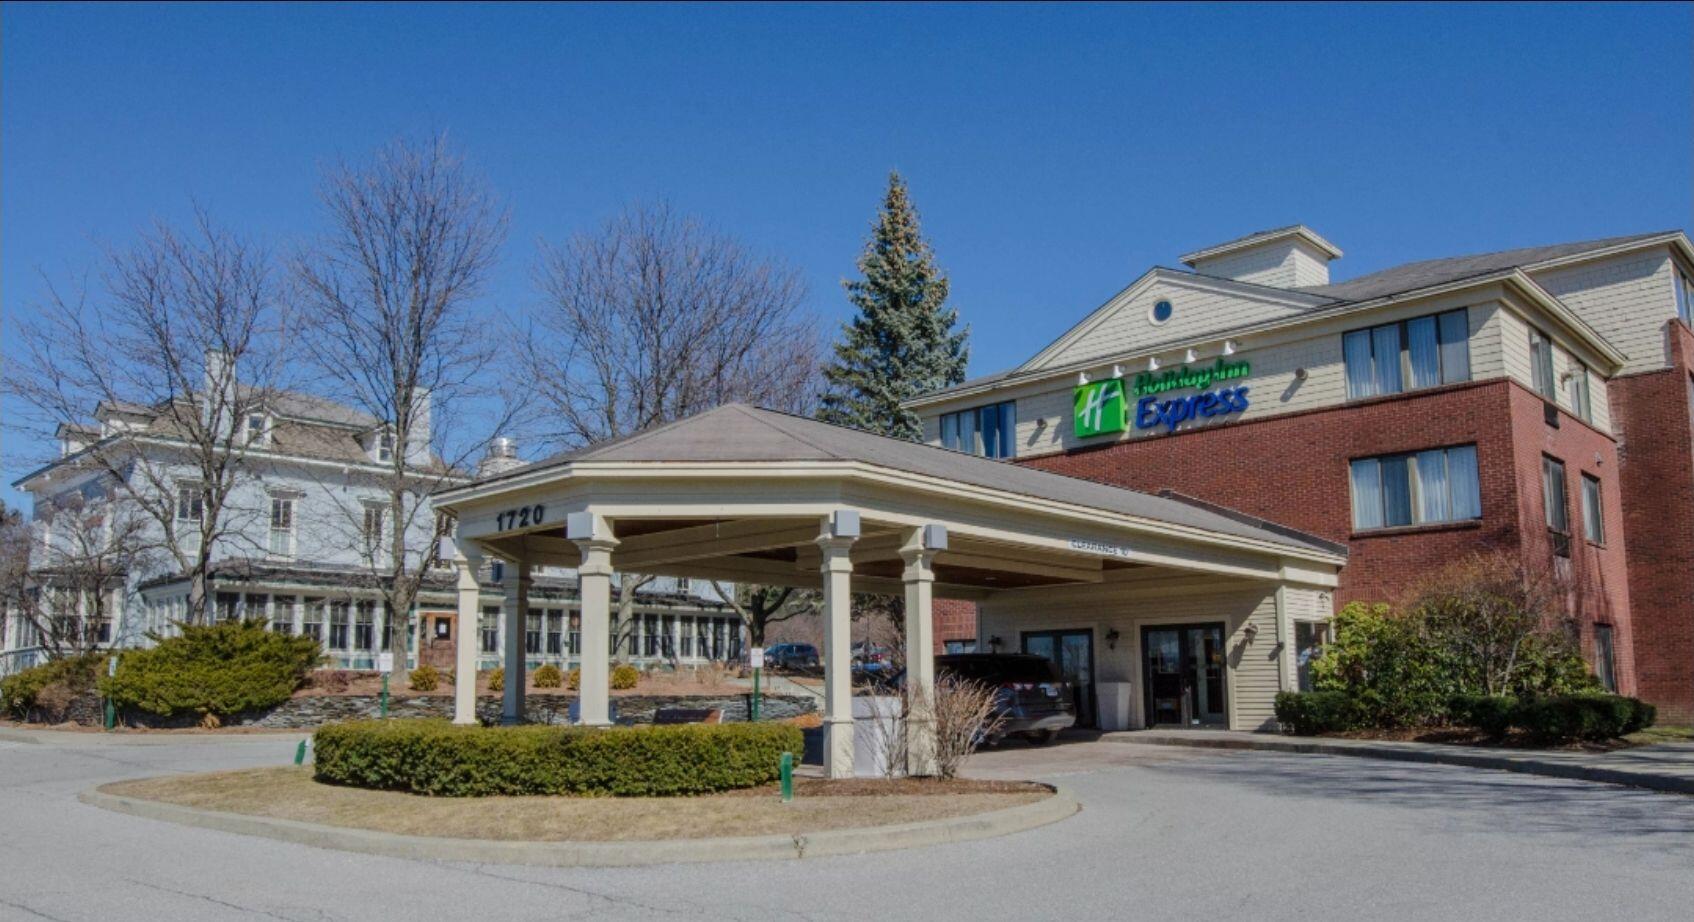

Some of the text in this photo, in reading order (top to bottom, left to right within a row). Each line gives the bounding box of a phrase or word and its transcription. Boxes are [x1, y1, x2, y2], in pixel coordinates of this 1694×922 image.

[1133, 356, 1250, 397] Holiday Inn
[1136, 386, 1249, 432] Express
[496, 504, 544, 532] 1720
